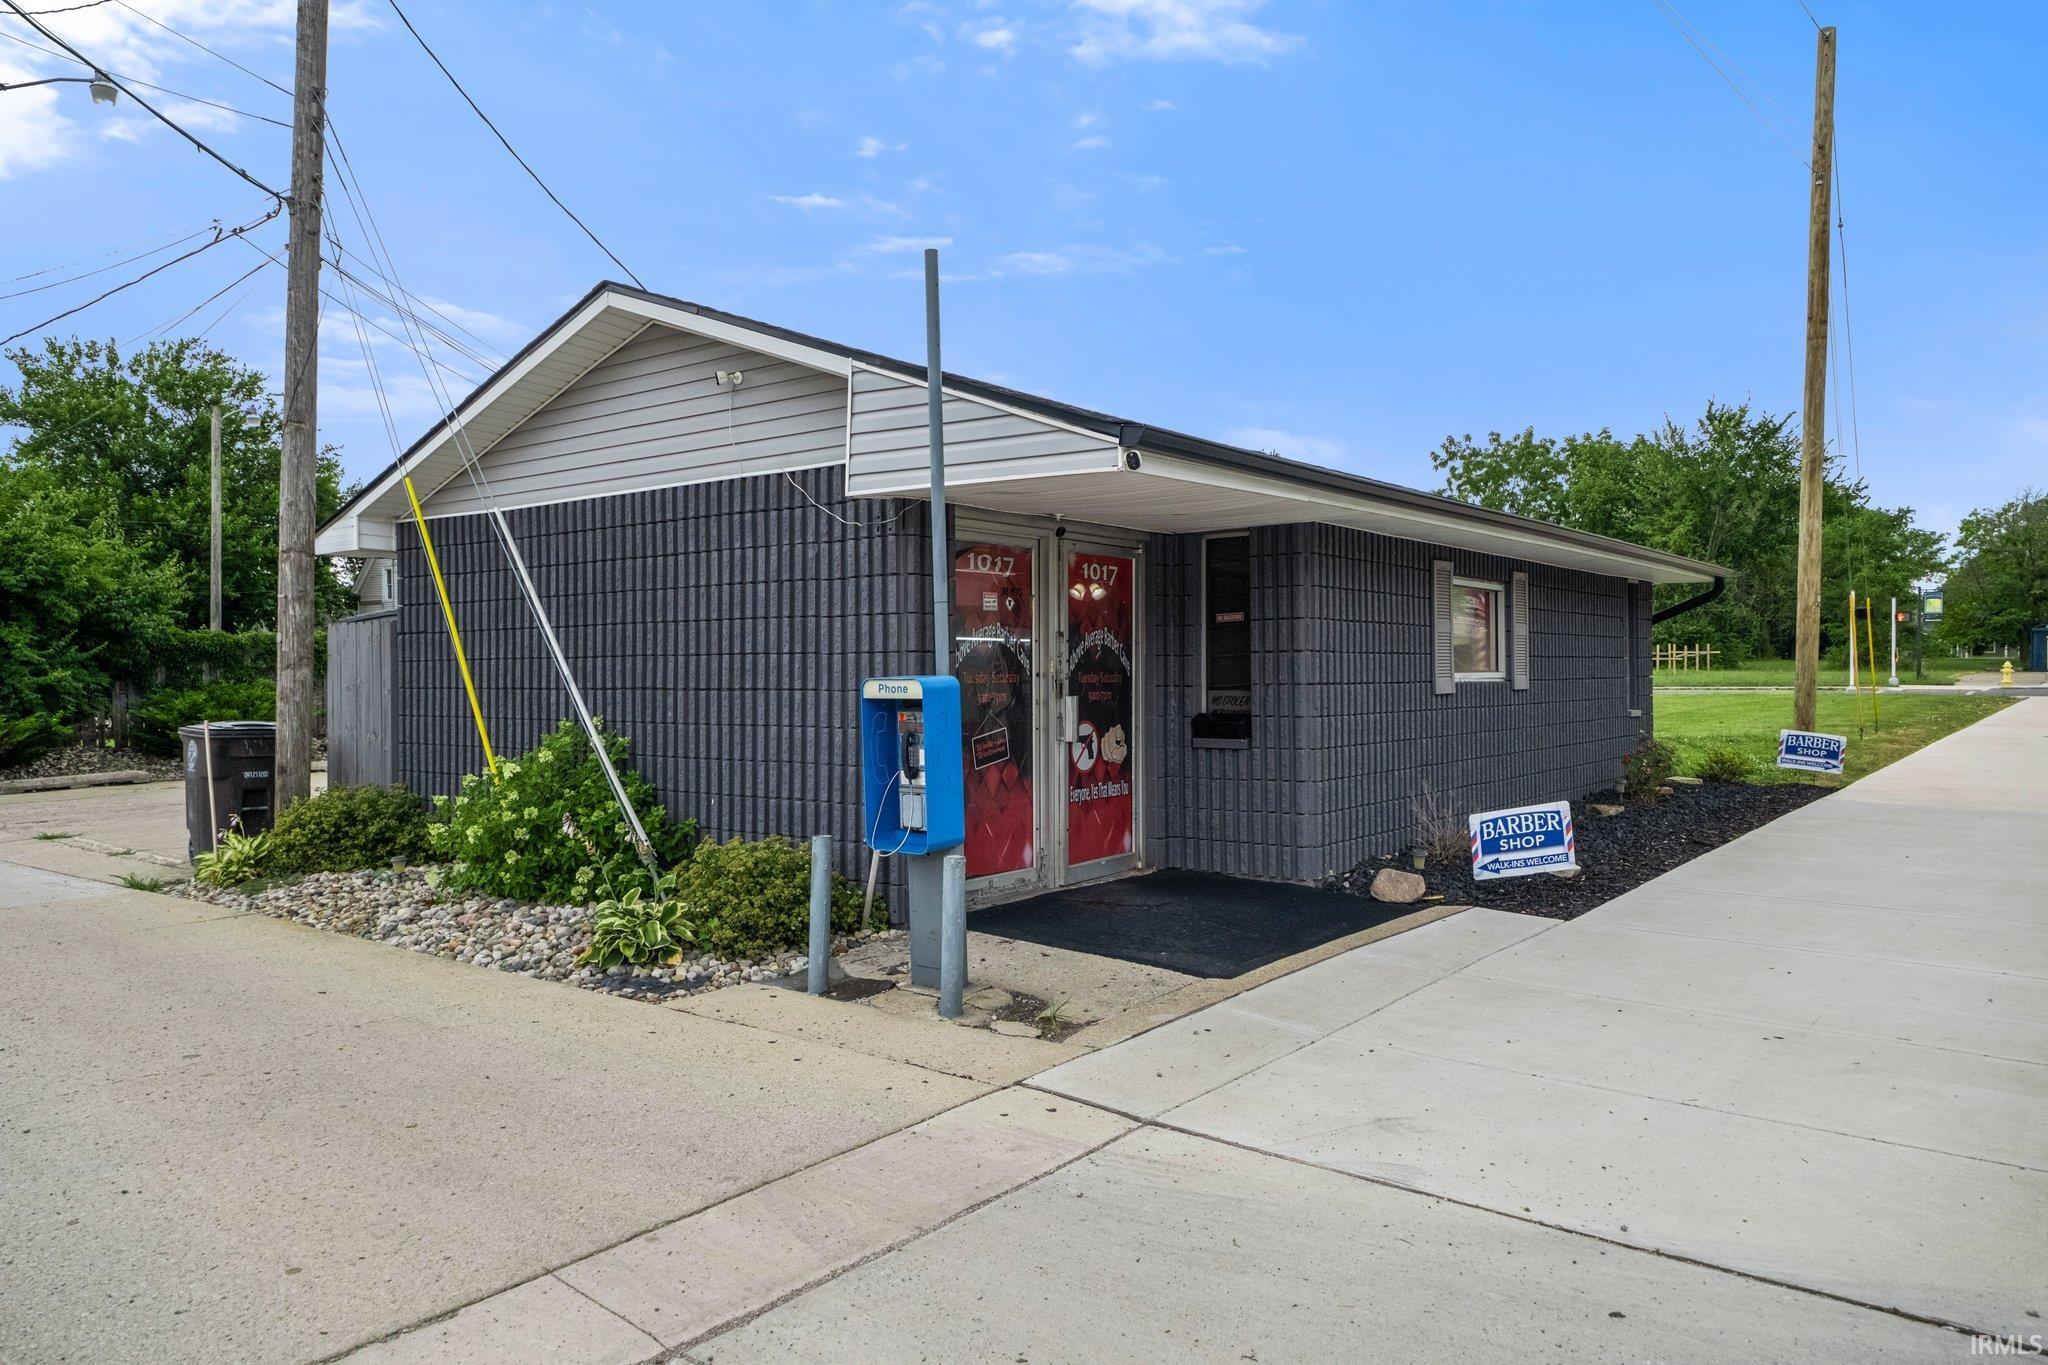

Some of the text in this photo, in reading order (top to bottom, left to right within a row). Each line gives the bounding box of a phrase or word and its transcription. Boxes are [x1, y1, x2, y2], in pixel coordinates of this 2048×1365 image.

[967, 552, 1014, 578] 1017
[1082, 562, 1118, 586] 1017
[878, 683, 909, 694] Phone
[1787, 735, 1839, 752] BARBER
[1797, 747, 1827, 757] SHOP
[1806, 760, 1833, 769] WELCOME
[1482, 812, 1562, 840] BARBER
[1500, 834, 1545, 851] SHOP
[1487, 853, 1568, 871] WALK-INS WELCOME
